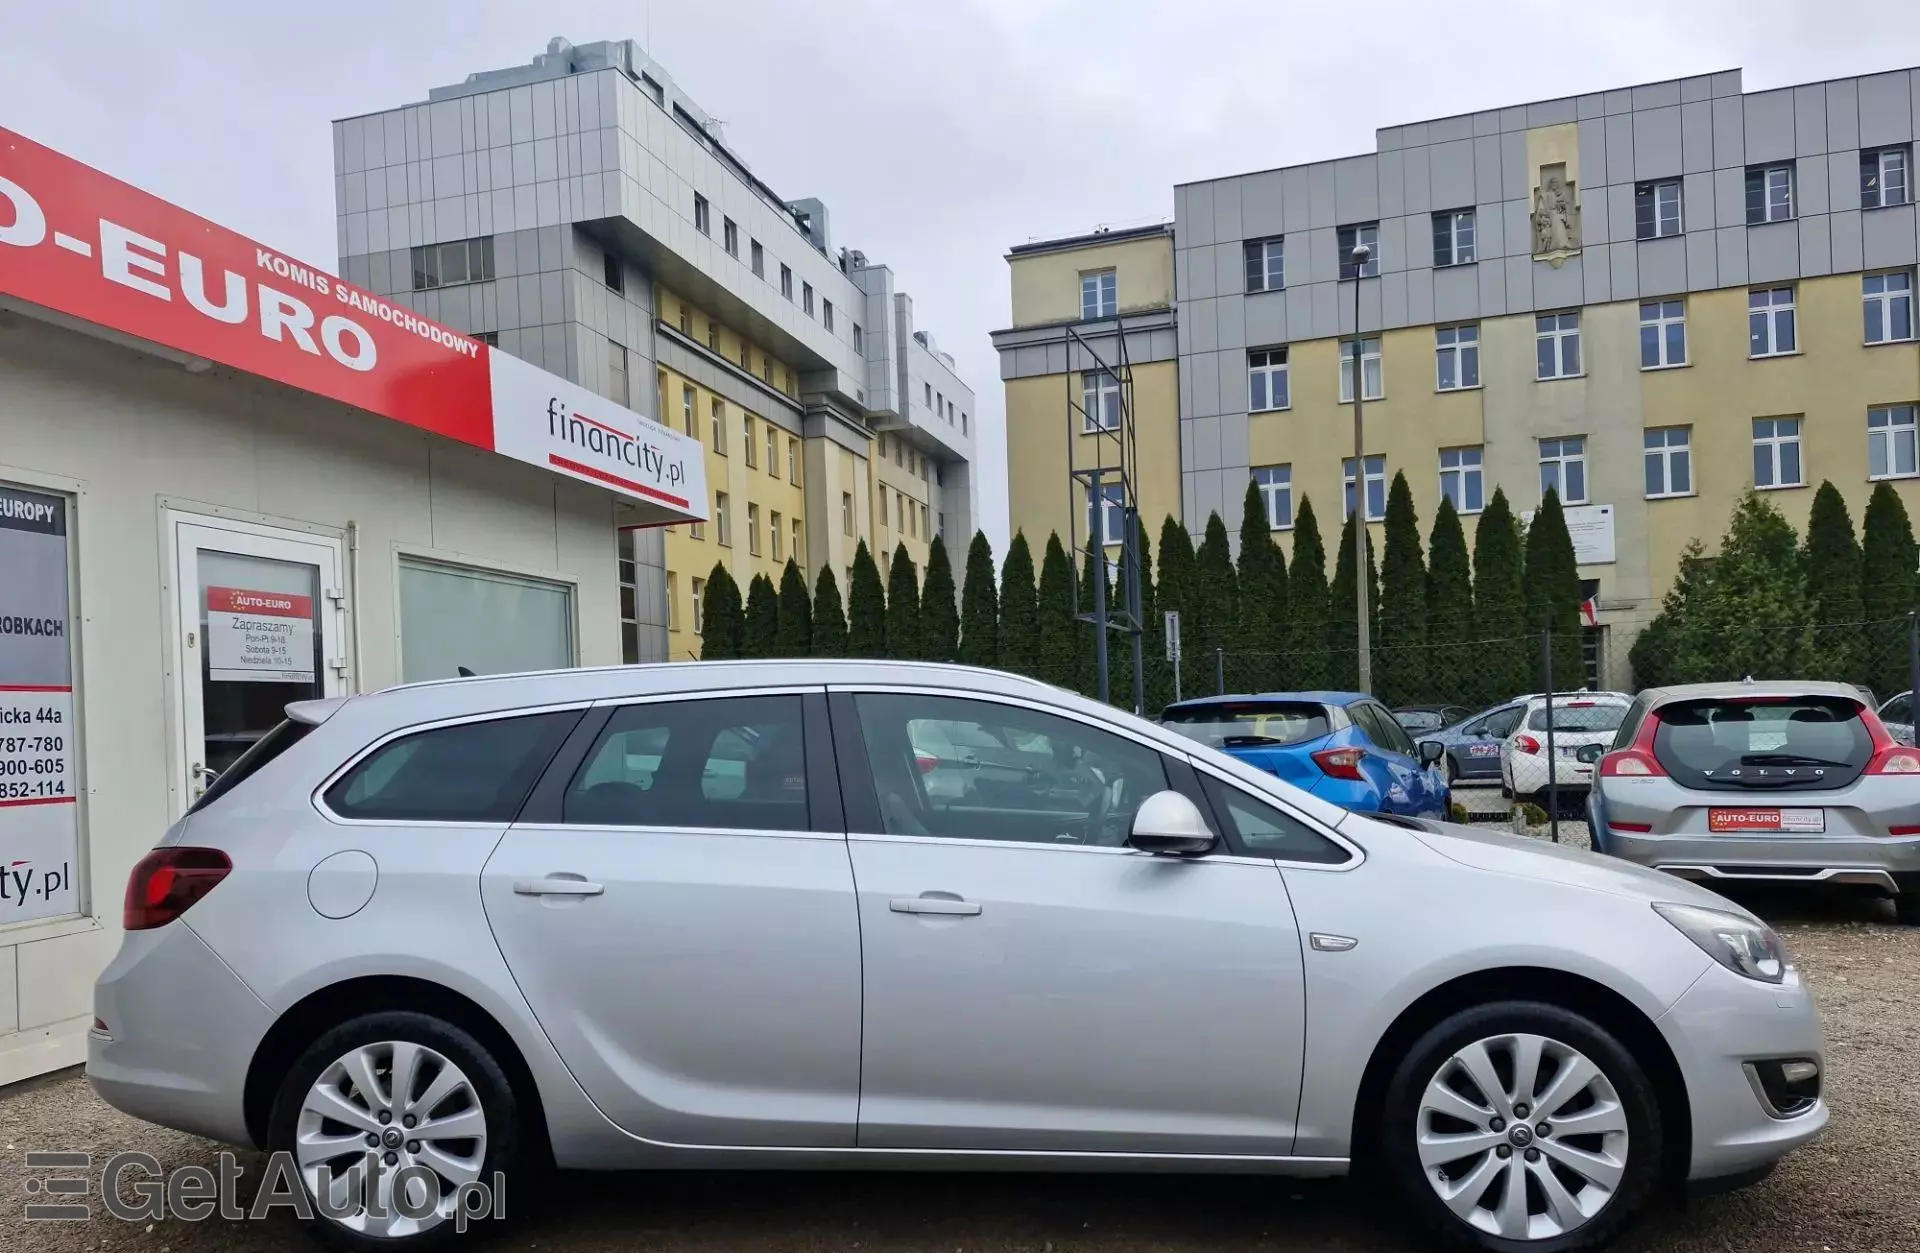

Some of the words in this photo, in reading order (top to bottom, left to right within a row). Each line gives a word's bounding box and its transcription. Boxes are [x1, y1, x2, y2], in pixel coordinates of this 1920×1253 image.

[256, 248, 329, 295] KOMIS
[335, 284, 479, 359] SAMOCHODOWY
[547, 397, 686, 487] financity.pl
[0, 498, 54, 523] UROPY
[236, 596, 291, 610] AUTO-EURO
[0, 616, 64, 637] OBKACH
[232, 617, 294, 636] Zapraszamy
[245, 645, 270, 654] Sobota
[271, 646, 287, 655] 9-15
[36, 707, 62, 724] 44a
[0, 758, 64, 776] 900-605
[1703, 768, 1824, 777] VOLVO
[0, 780, 65, 798] 852-114
[1716, 813, 1780, 824] AUTO-EURO
